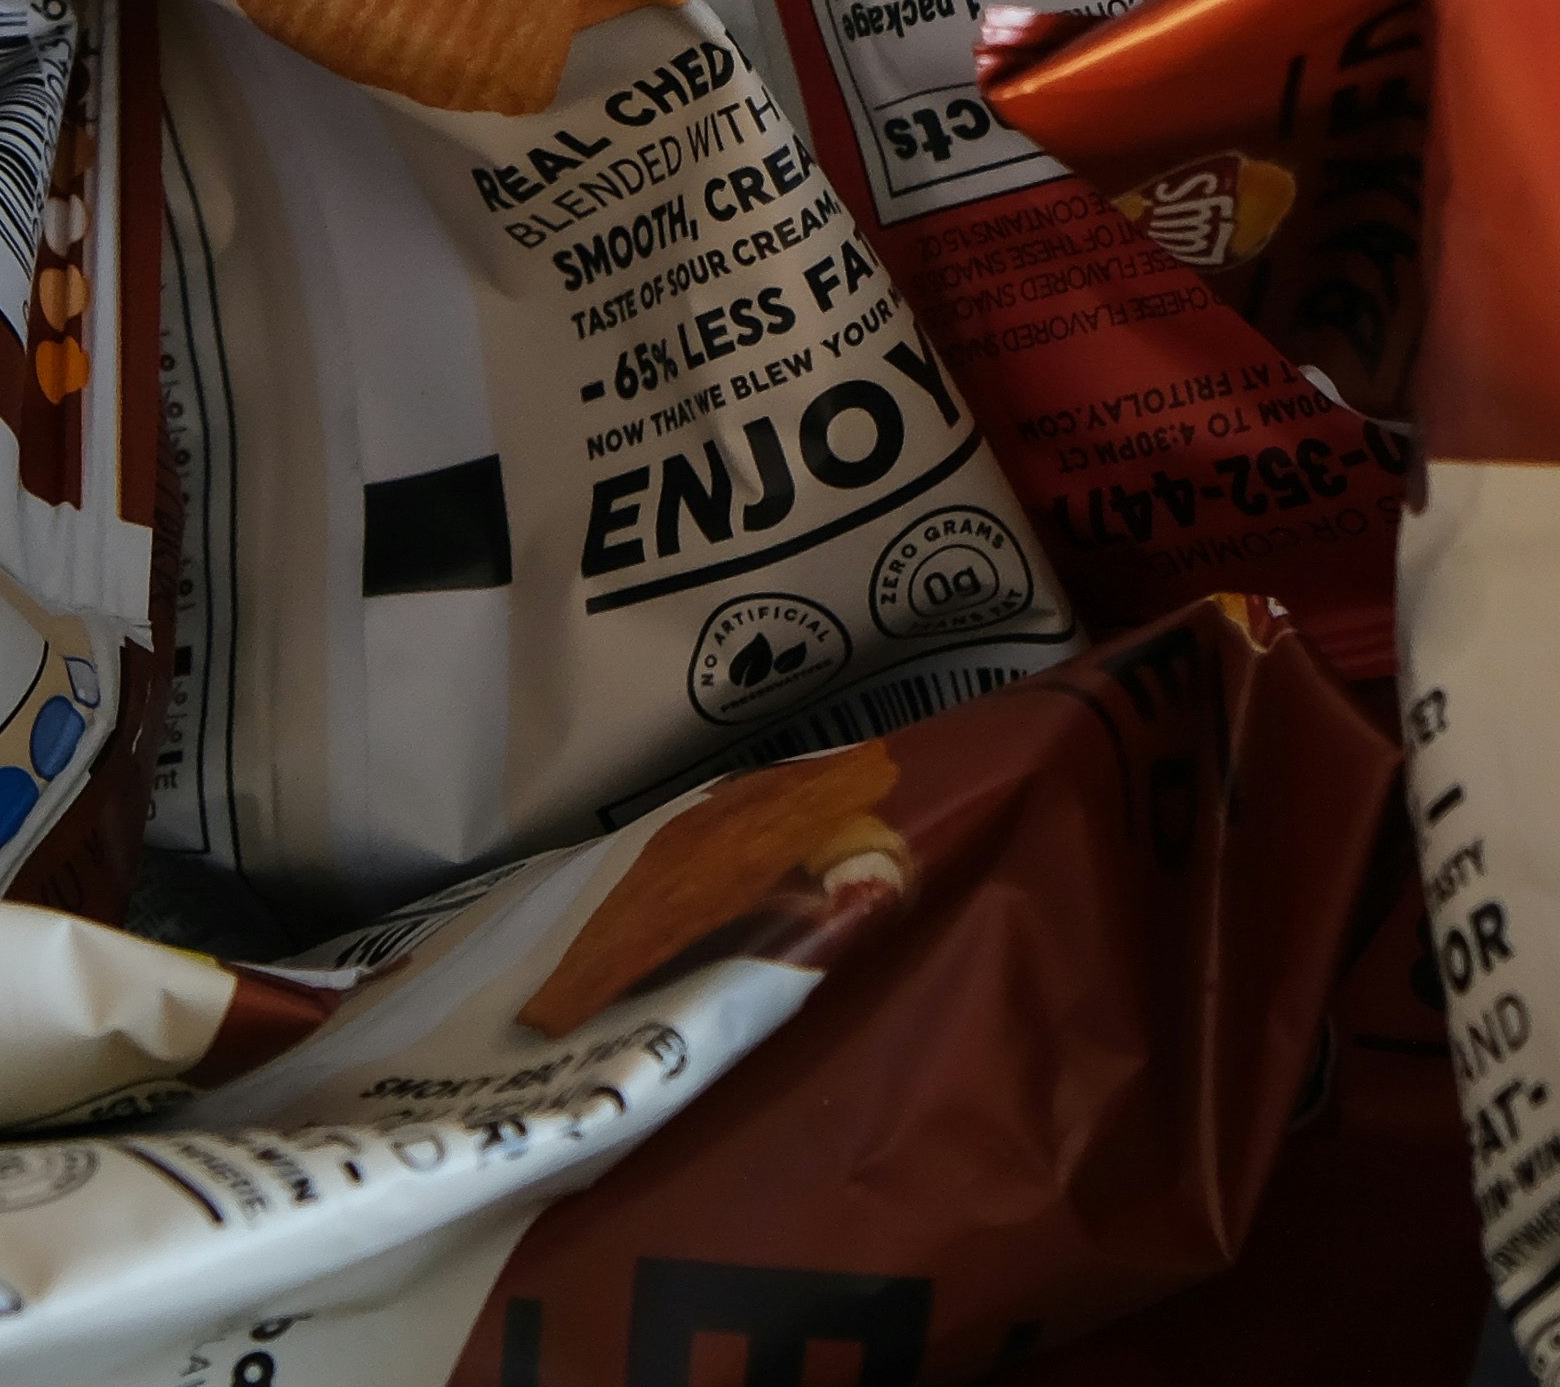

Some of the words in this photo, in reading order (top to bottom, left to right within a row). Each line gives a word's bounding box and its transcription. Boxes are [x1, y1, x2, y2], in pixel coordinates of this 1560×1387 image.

[471, 127, 610, 213] REAL
[506, 133, 682, 249] BLENDED
[689, 95, 781, 158] WITH
[551, 197, 699, 293] SMOOTH,
[615, 341, 679, 402] 65%
[681, 286, 796, 371] LESS
[732, 346, 815, 402] BLEW
[821, 299, 891, 361] YOUR
[581, 341, 962, 580] ENJOY
